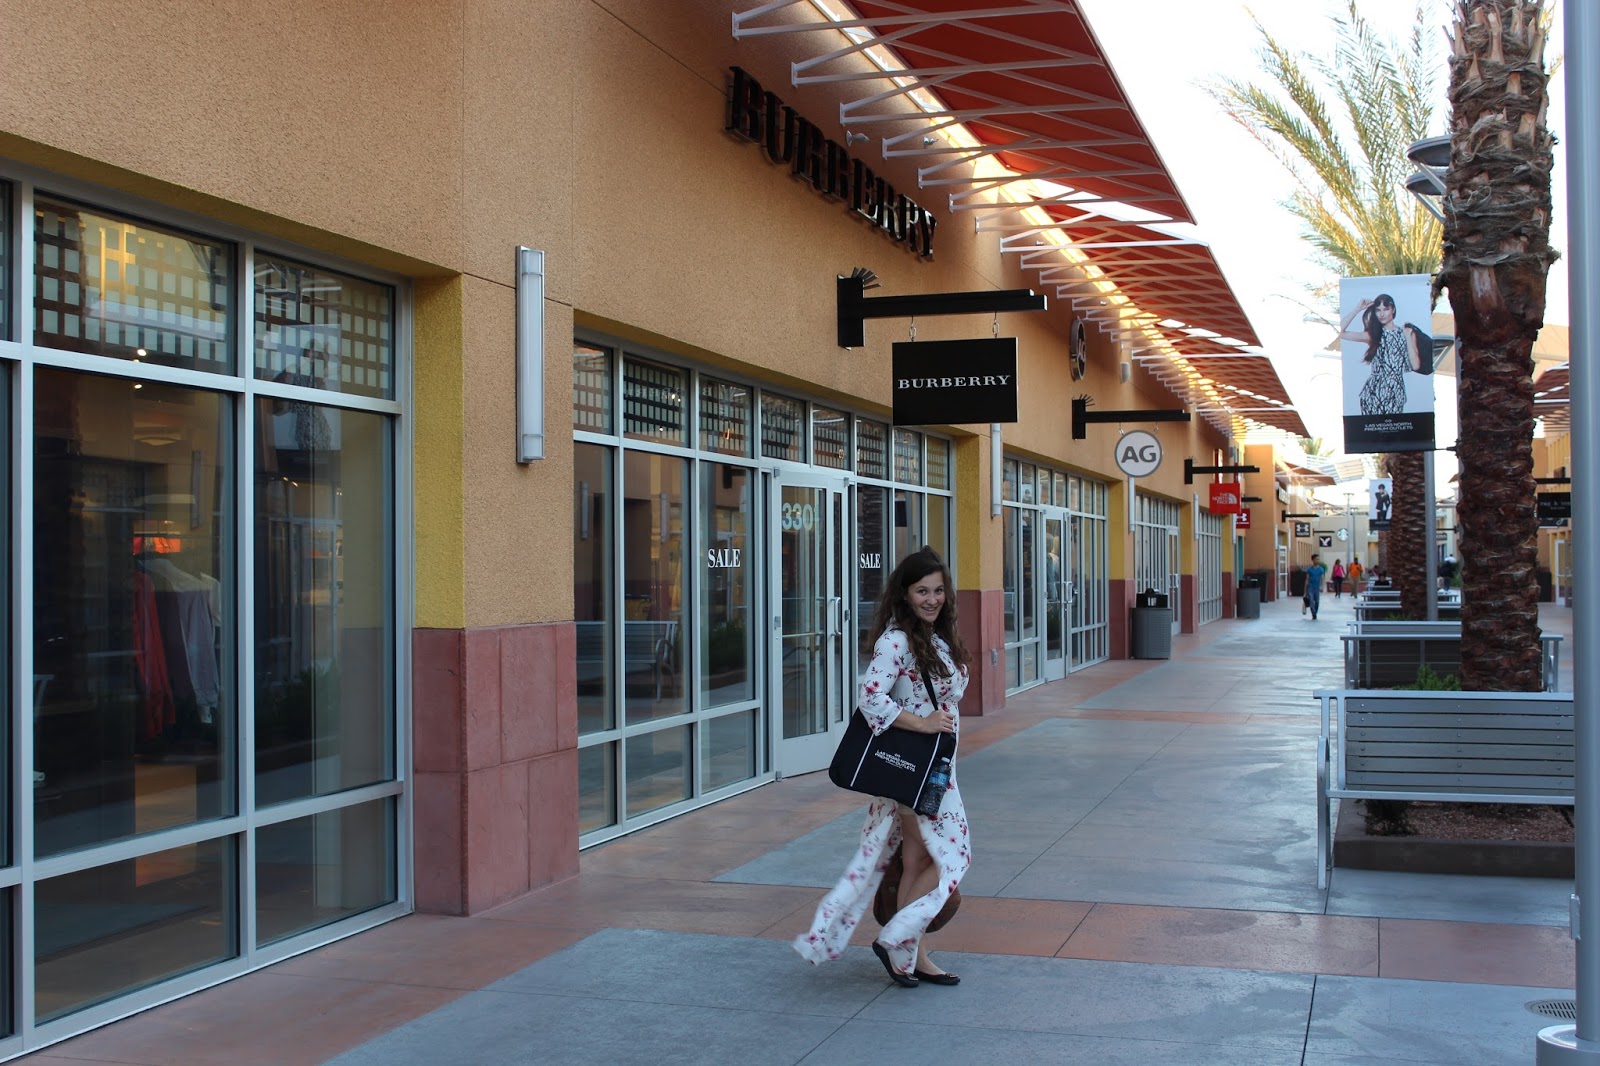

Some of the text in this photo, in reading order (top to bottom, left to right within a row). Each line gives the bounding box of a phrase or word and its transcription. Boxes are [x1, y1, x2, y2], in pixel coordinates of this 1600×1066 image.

[725, 66, 938, 262] BURBERRY
[898, 375, 1011, 389] BURBERRY
[1121, 445, 1157, 464] AG
[707, 548, 741, 568] SALE
[860, 553, 881, 569] SALE
